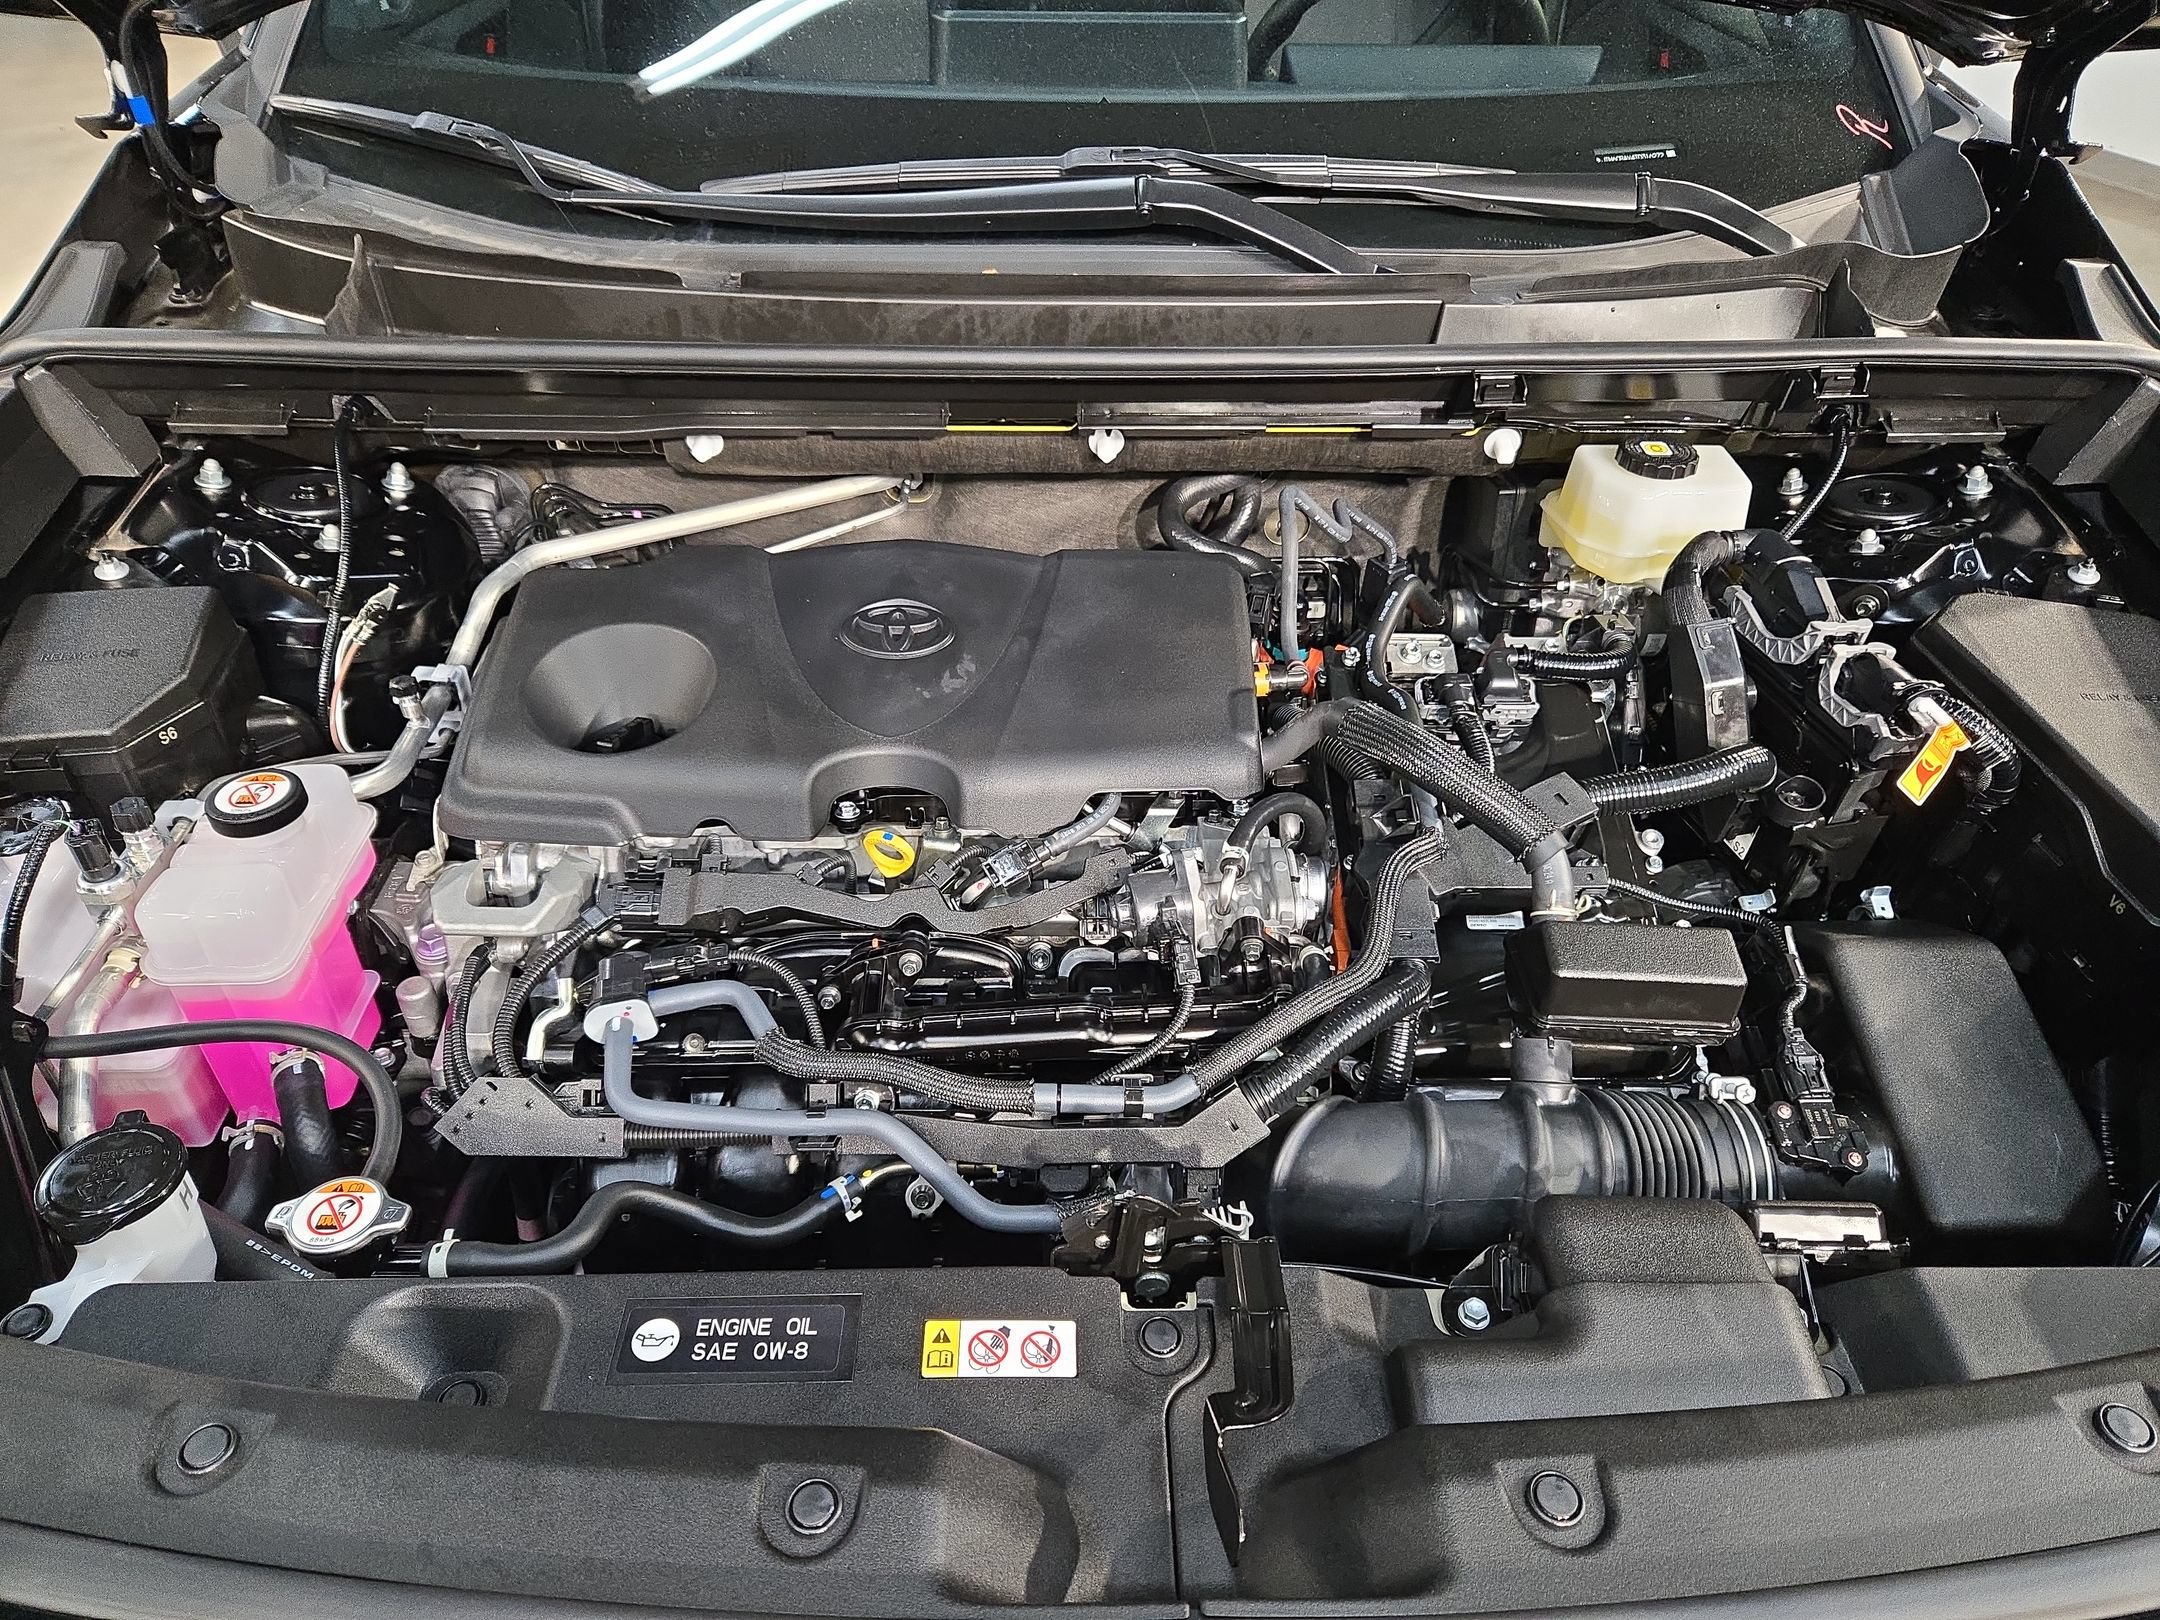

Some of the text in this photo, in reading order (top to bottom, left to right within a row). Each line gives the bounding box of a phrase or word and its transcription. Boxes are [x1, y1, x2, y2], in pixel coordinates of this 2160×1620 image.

[2080, 692, 2120, 702] RELAY
[158, 726, 178, 745] S6
[2110, 894, 2126, 915] V6
[178, 1180, 194, 1212] H
[696, 1317, 818, 1337] ENGINE OIL
[691, 1342, 739, 1361] SAE
